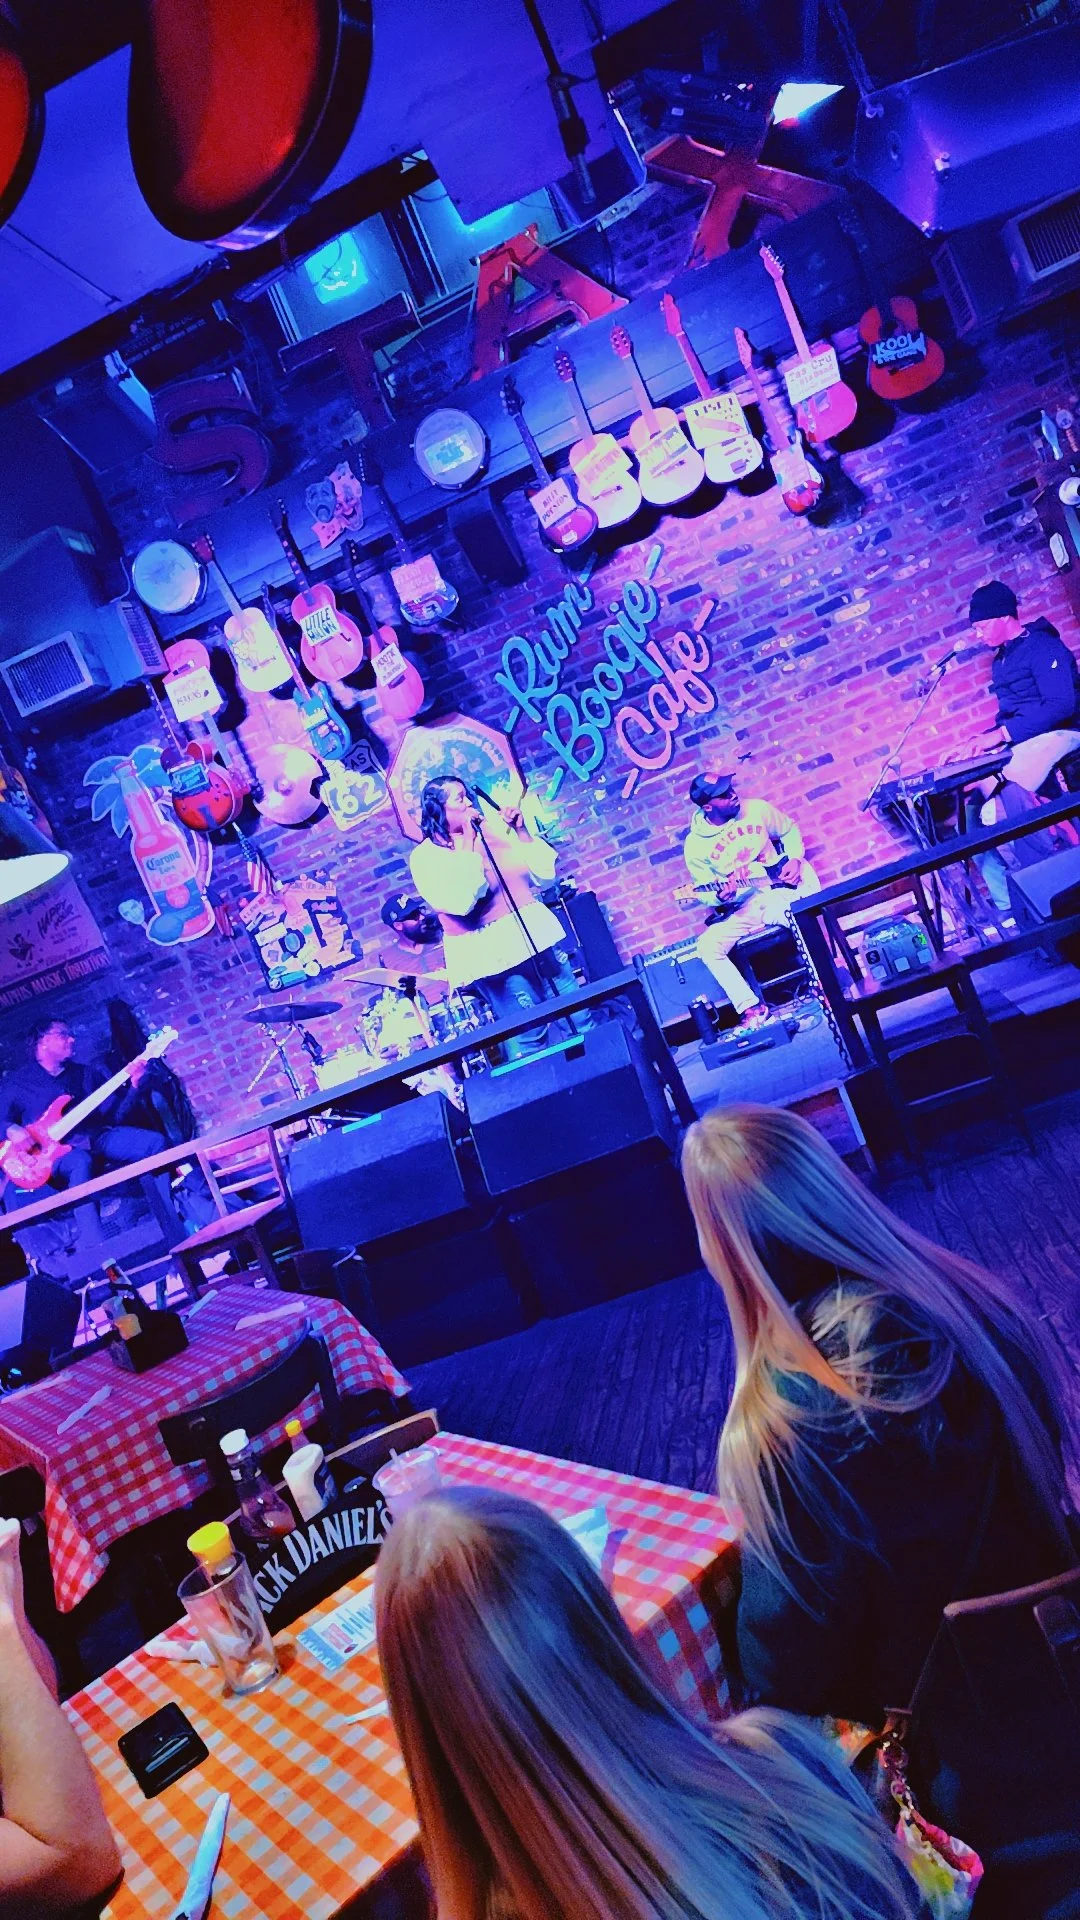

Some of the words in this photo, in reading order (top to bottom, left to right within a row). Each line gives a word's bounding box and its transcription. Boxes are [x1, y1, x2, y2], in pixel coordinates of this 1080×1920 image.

[875, 332, 913, 355] KOOL
[494, 582, 593, 724] Rum
[542, 580, 662, 782] Boogie
[615, 631, 717, 771] Cafe
[337, 775, 384, 815] 62
[146, 851, 181, 870] Corona
[710, 824, 763, 861] CHICAGO
[37, 899, 67, 940] HAPPY
[30, 970, 66, 995] MUSIC
[253, 1552, 297, 1614] CK
